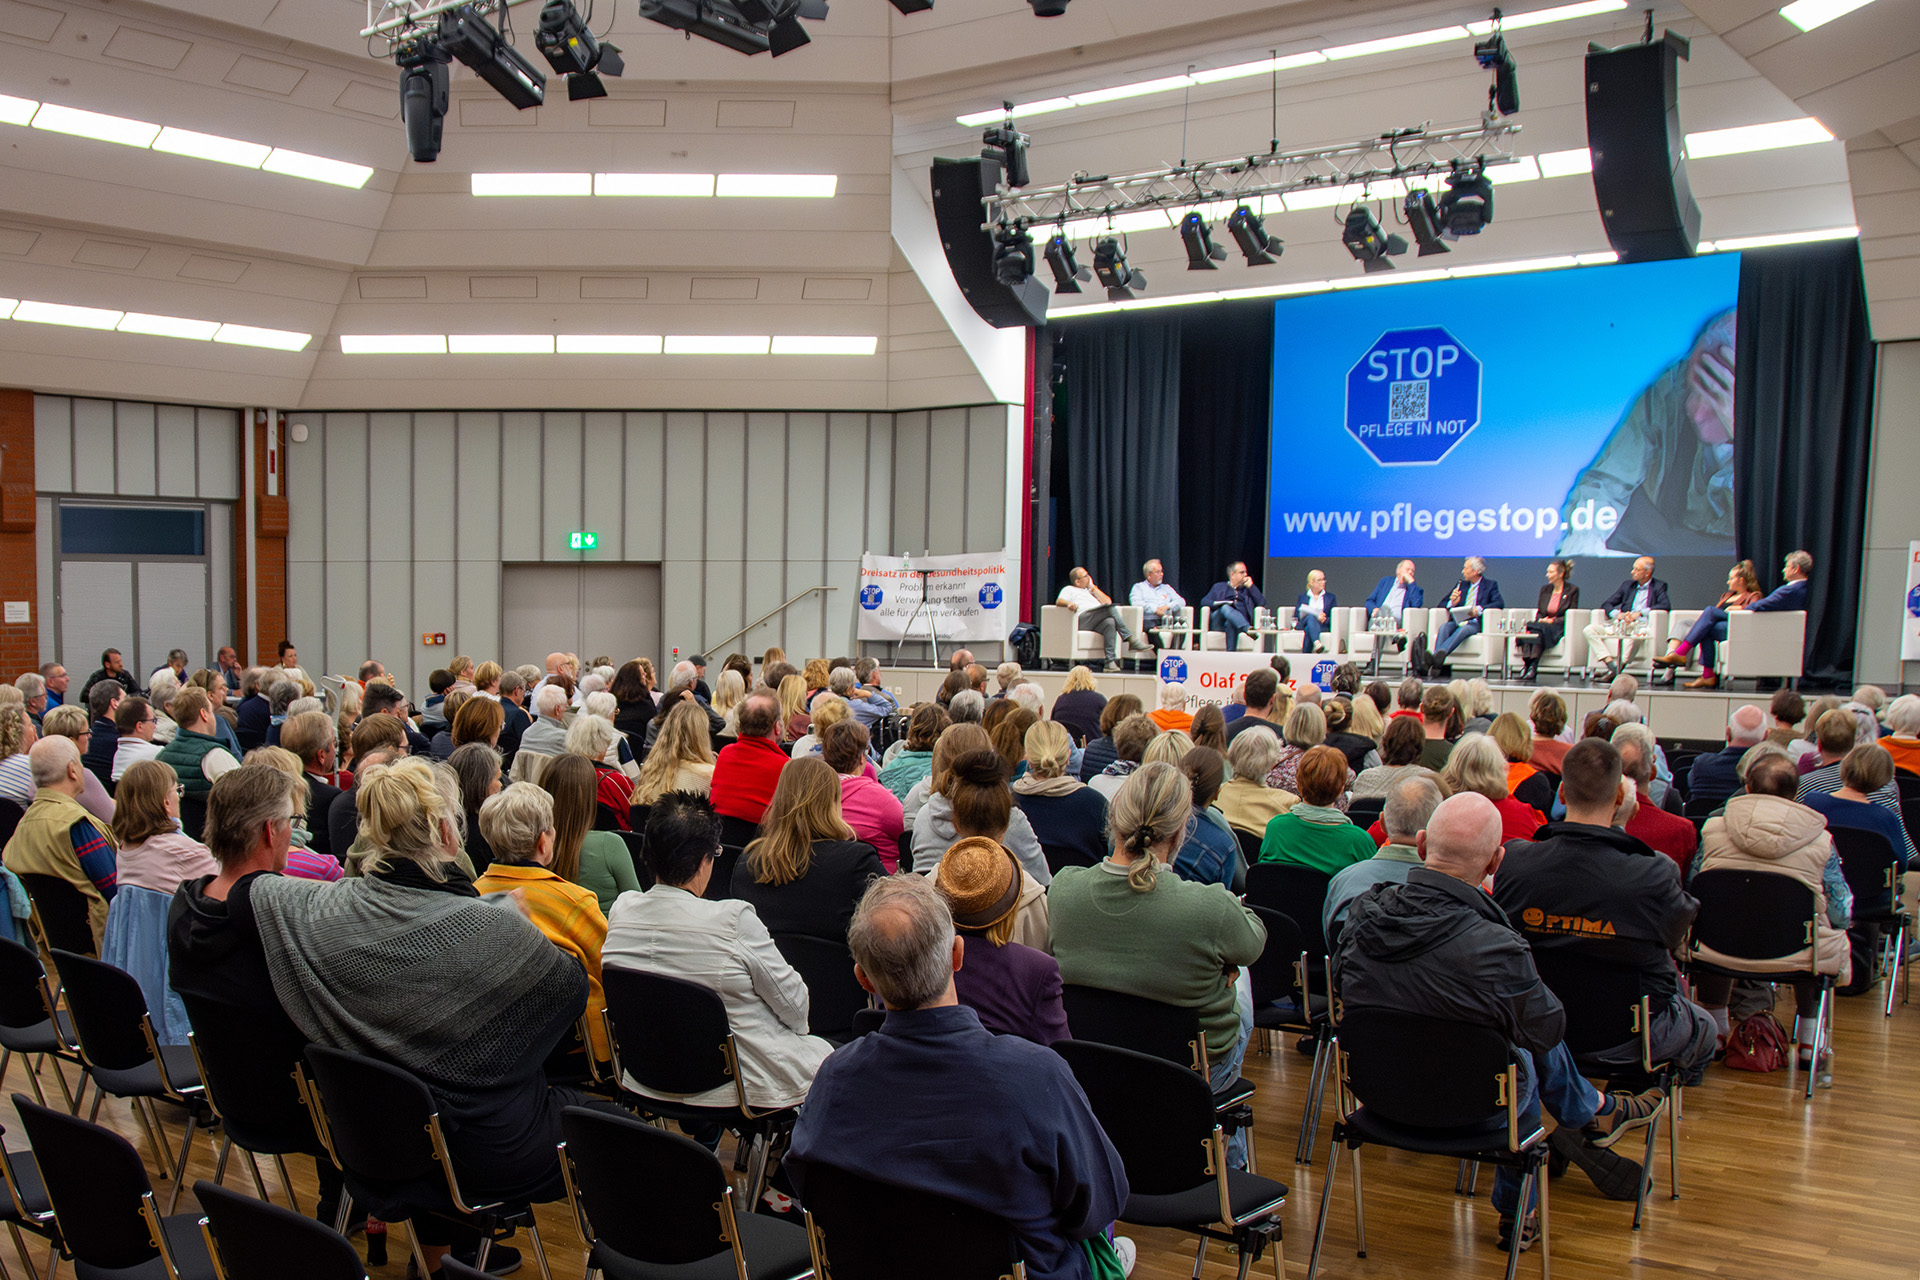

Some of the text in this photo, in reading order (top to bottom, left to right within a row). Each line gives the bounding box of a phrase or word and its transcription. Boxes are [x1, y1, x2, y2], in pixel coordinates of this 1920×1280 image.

[1367, 345, 1459, 382] STOP
[1359, 419, 1467, 438] PFLEGE IN NOT
[1284, 499, 1618, 539] www.pflegestop.de
[860, 568, 897, 578] Dreisatz
[899, 570, 908, 578] in
[863, 587, 881, 595] STOP
[899, 582, 966, 592] Problm erkannt
[982, 585, 1000, 594] STOP
[895, 594, 968, 607] Verwirung stiften
[880, 607, 895, 617] alle
[896, 607, 909, 617] für
[940, 606, 979, 617] verkaufen
[1164, 659, 1184, 668] STOP
[1200, 672, 1236, 688] Olaf
